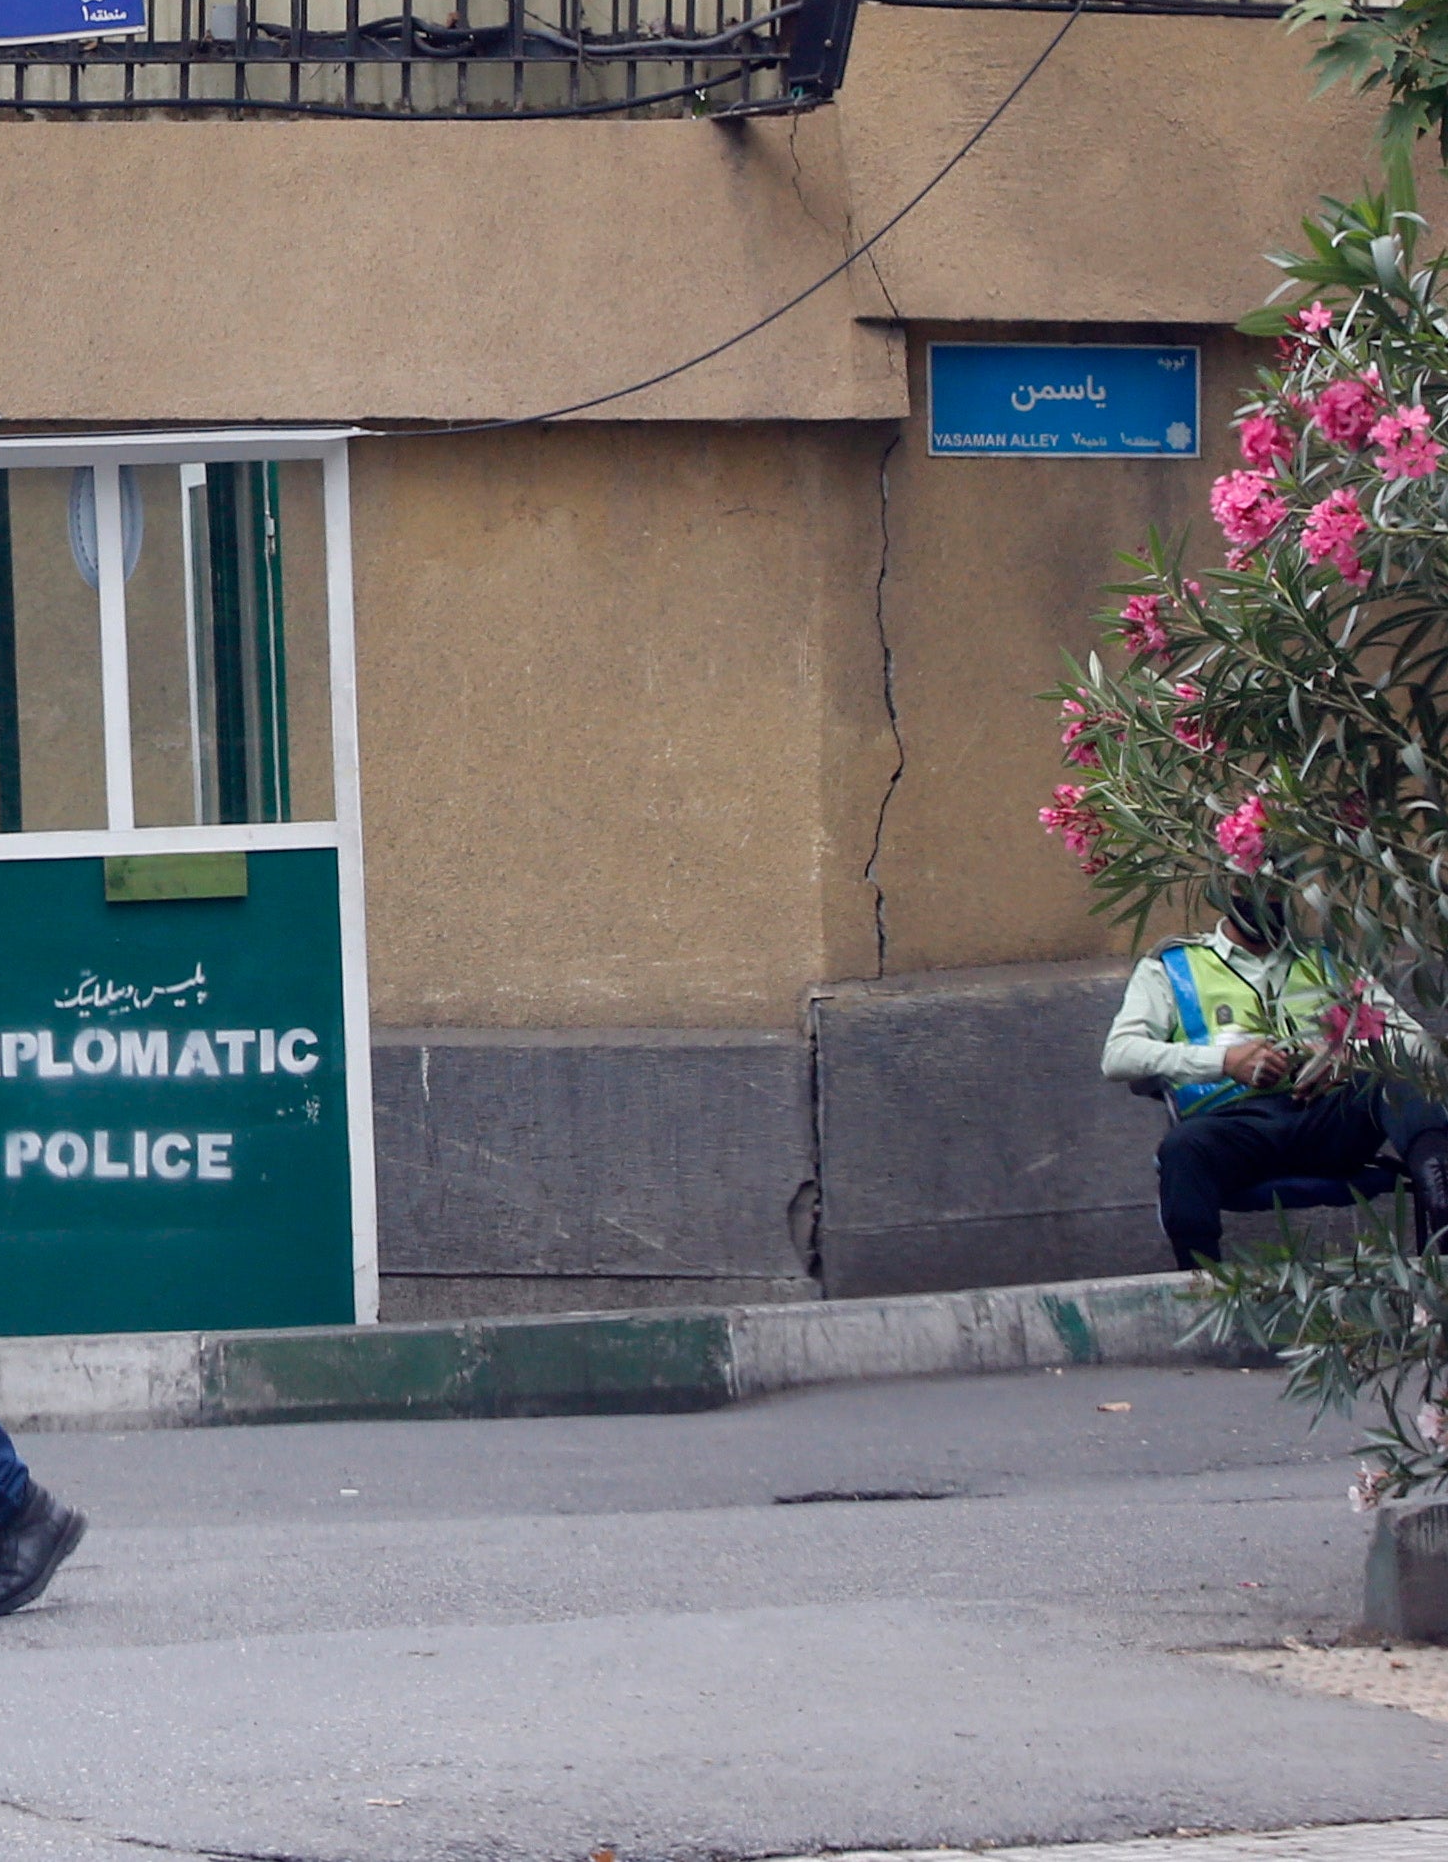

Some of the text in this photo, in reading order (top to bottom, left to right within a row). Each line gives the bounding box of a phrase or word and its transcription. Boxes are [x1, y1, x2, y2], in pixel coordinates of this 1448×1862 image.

[1011, 375, 1107, 411] یاسمن
[934, 433, 1059, 447] YASAMAN ALLEY
[133, 961, 208, 1010] پلیس
[5, 1131, 234, 1180] POLICE
